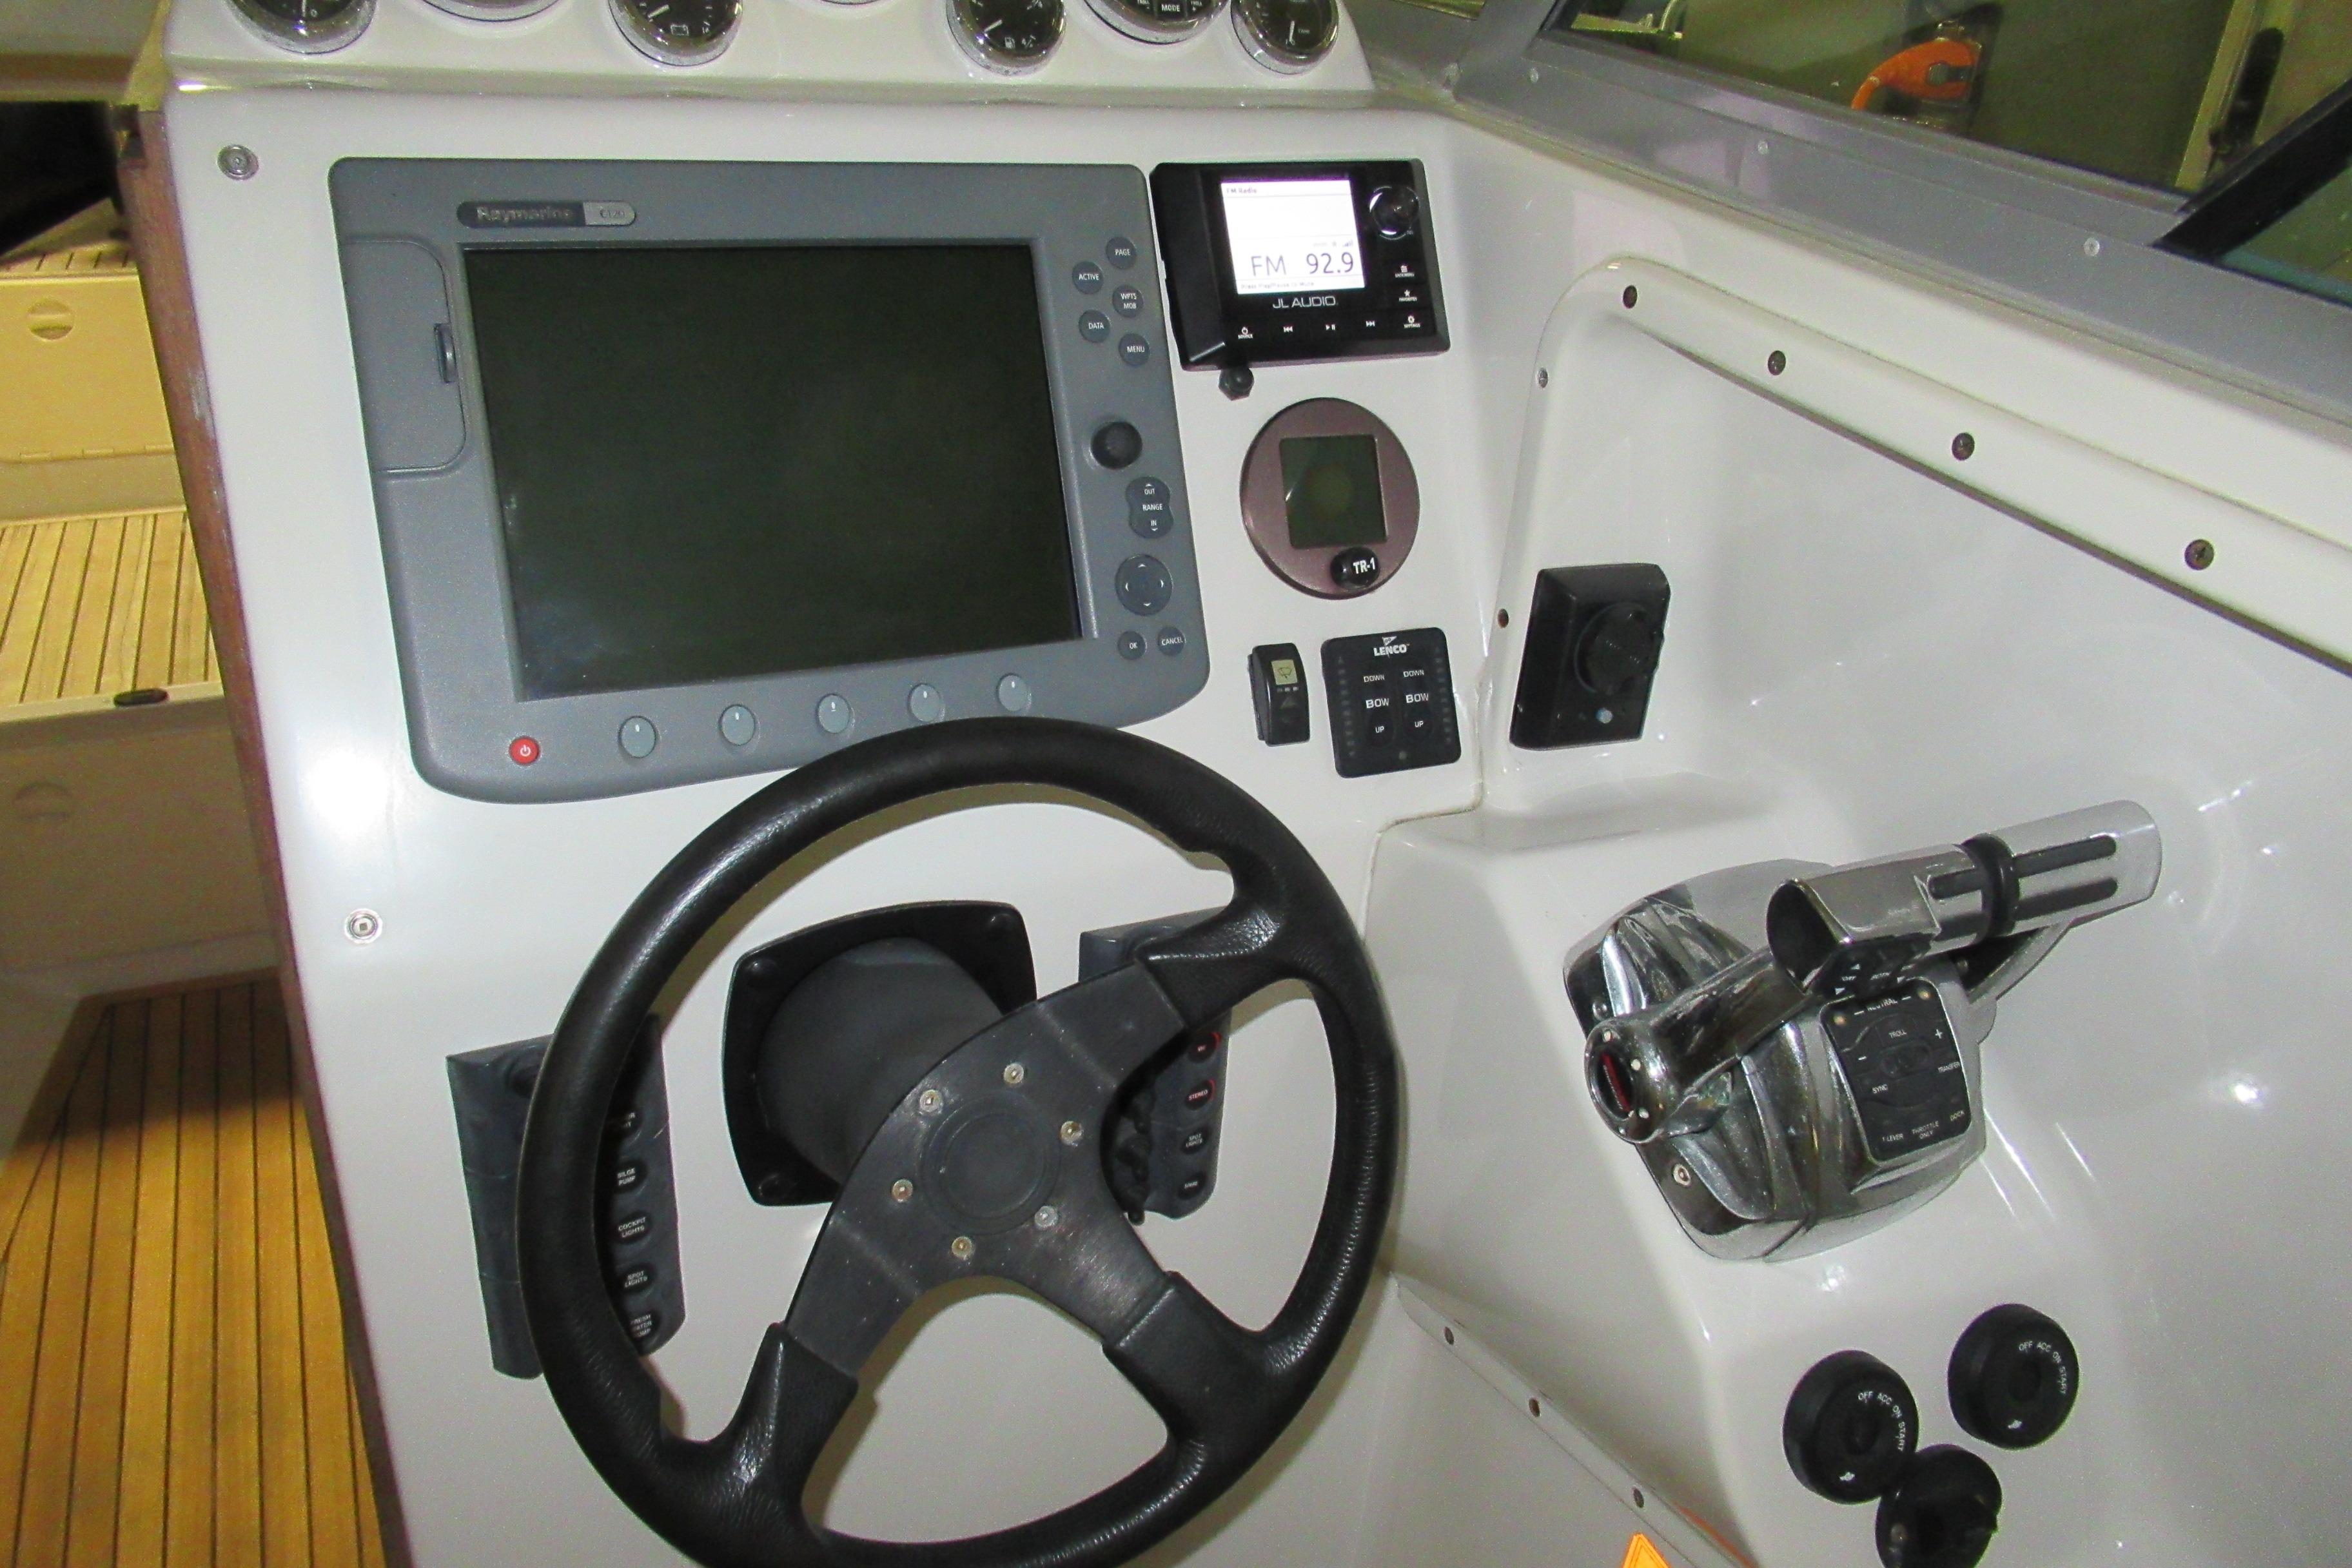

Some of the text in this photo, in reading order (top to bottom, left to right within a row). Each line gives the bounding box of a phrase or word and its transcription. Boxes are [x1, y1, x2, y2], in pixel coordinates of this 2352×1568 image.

[1161, 4, 1181, 12] MODE
[1251, 252, 1353, 276] FM 92.9
[1272, 296, 1337, 309] JL AUDIO
[1353, 558, 1376, 574] TR-1
[1161, 637, 1184, 645] CANCEL
[1373, 643, 1407, 657] LENCO
[1363, 674, 1385, 683] DOWN
[1403, 669, 1425, 678] DOWN
[1405, 692, 1429, 703] BOW
[1366, 698, 1389, 709] BOW
[1375, 725, 1385, 734] UP
[1415, 720, 1424, 729] UP
[1888, 1029, 1907, 1039] TROLL
[1188, 1088, 1209, 1100] STEREO
[1872, 1084, 1889, 1094] SYNC
[618, 1217, 647, 1231] COCKPIT
[621, 1225, 645, 1238] LIGHTS
[624, 1276, 648, 1288] LIGHTS
[2018, 1341, 2033, 1351] OFF
[2036, 1342, 2052, 1352] ACC
[2052, 1351, 2062, 1364] ON
[1857, 1391, 1873, 1401] OFF
[1877, 1392, 1892, 1405] ACC
[1892, 1405, 1903, 1418] ON
